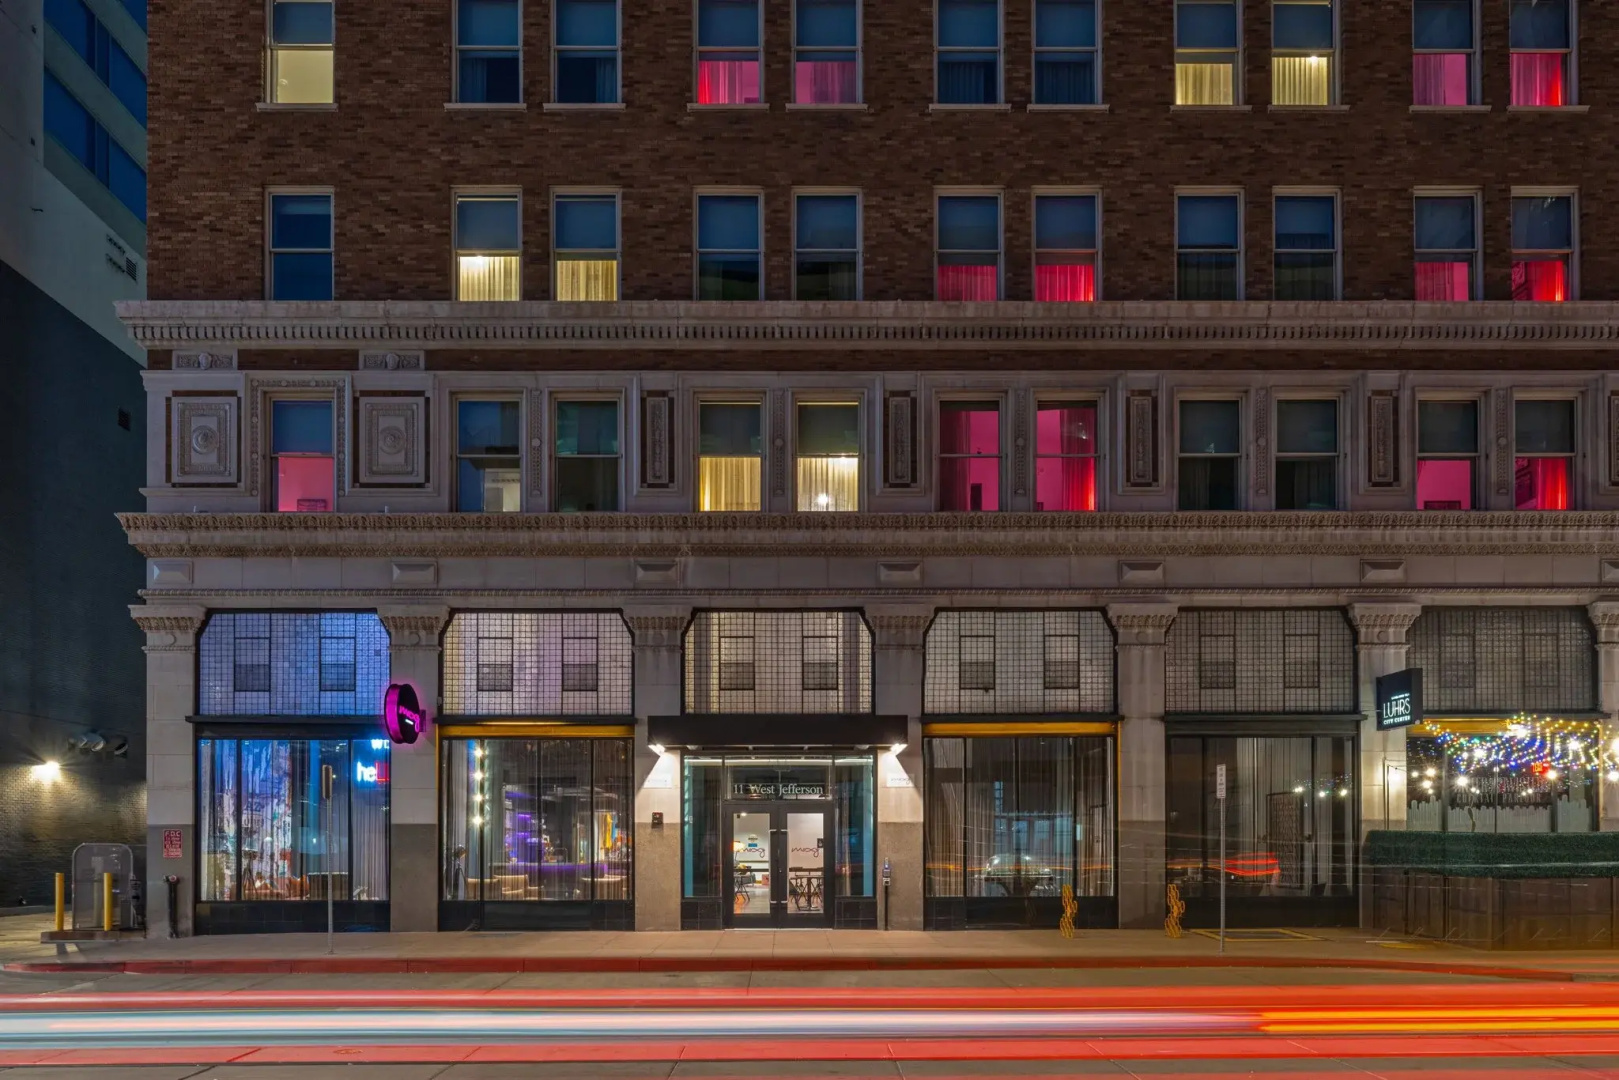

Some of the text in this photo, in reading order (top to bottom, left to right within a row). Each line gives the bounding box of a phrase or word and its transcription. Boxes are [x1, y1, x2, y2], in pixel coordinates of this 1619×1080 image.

[1383, 698, 1411, 718] LUHRS
[1394, 715, 1411, 723] CENTER
[733, 783, 824, 796] 11 West Jefferson
